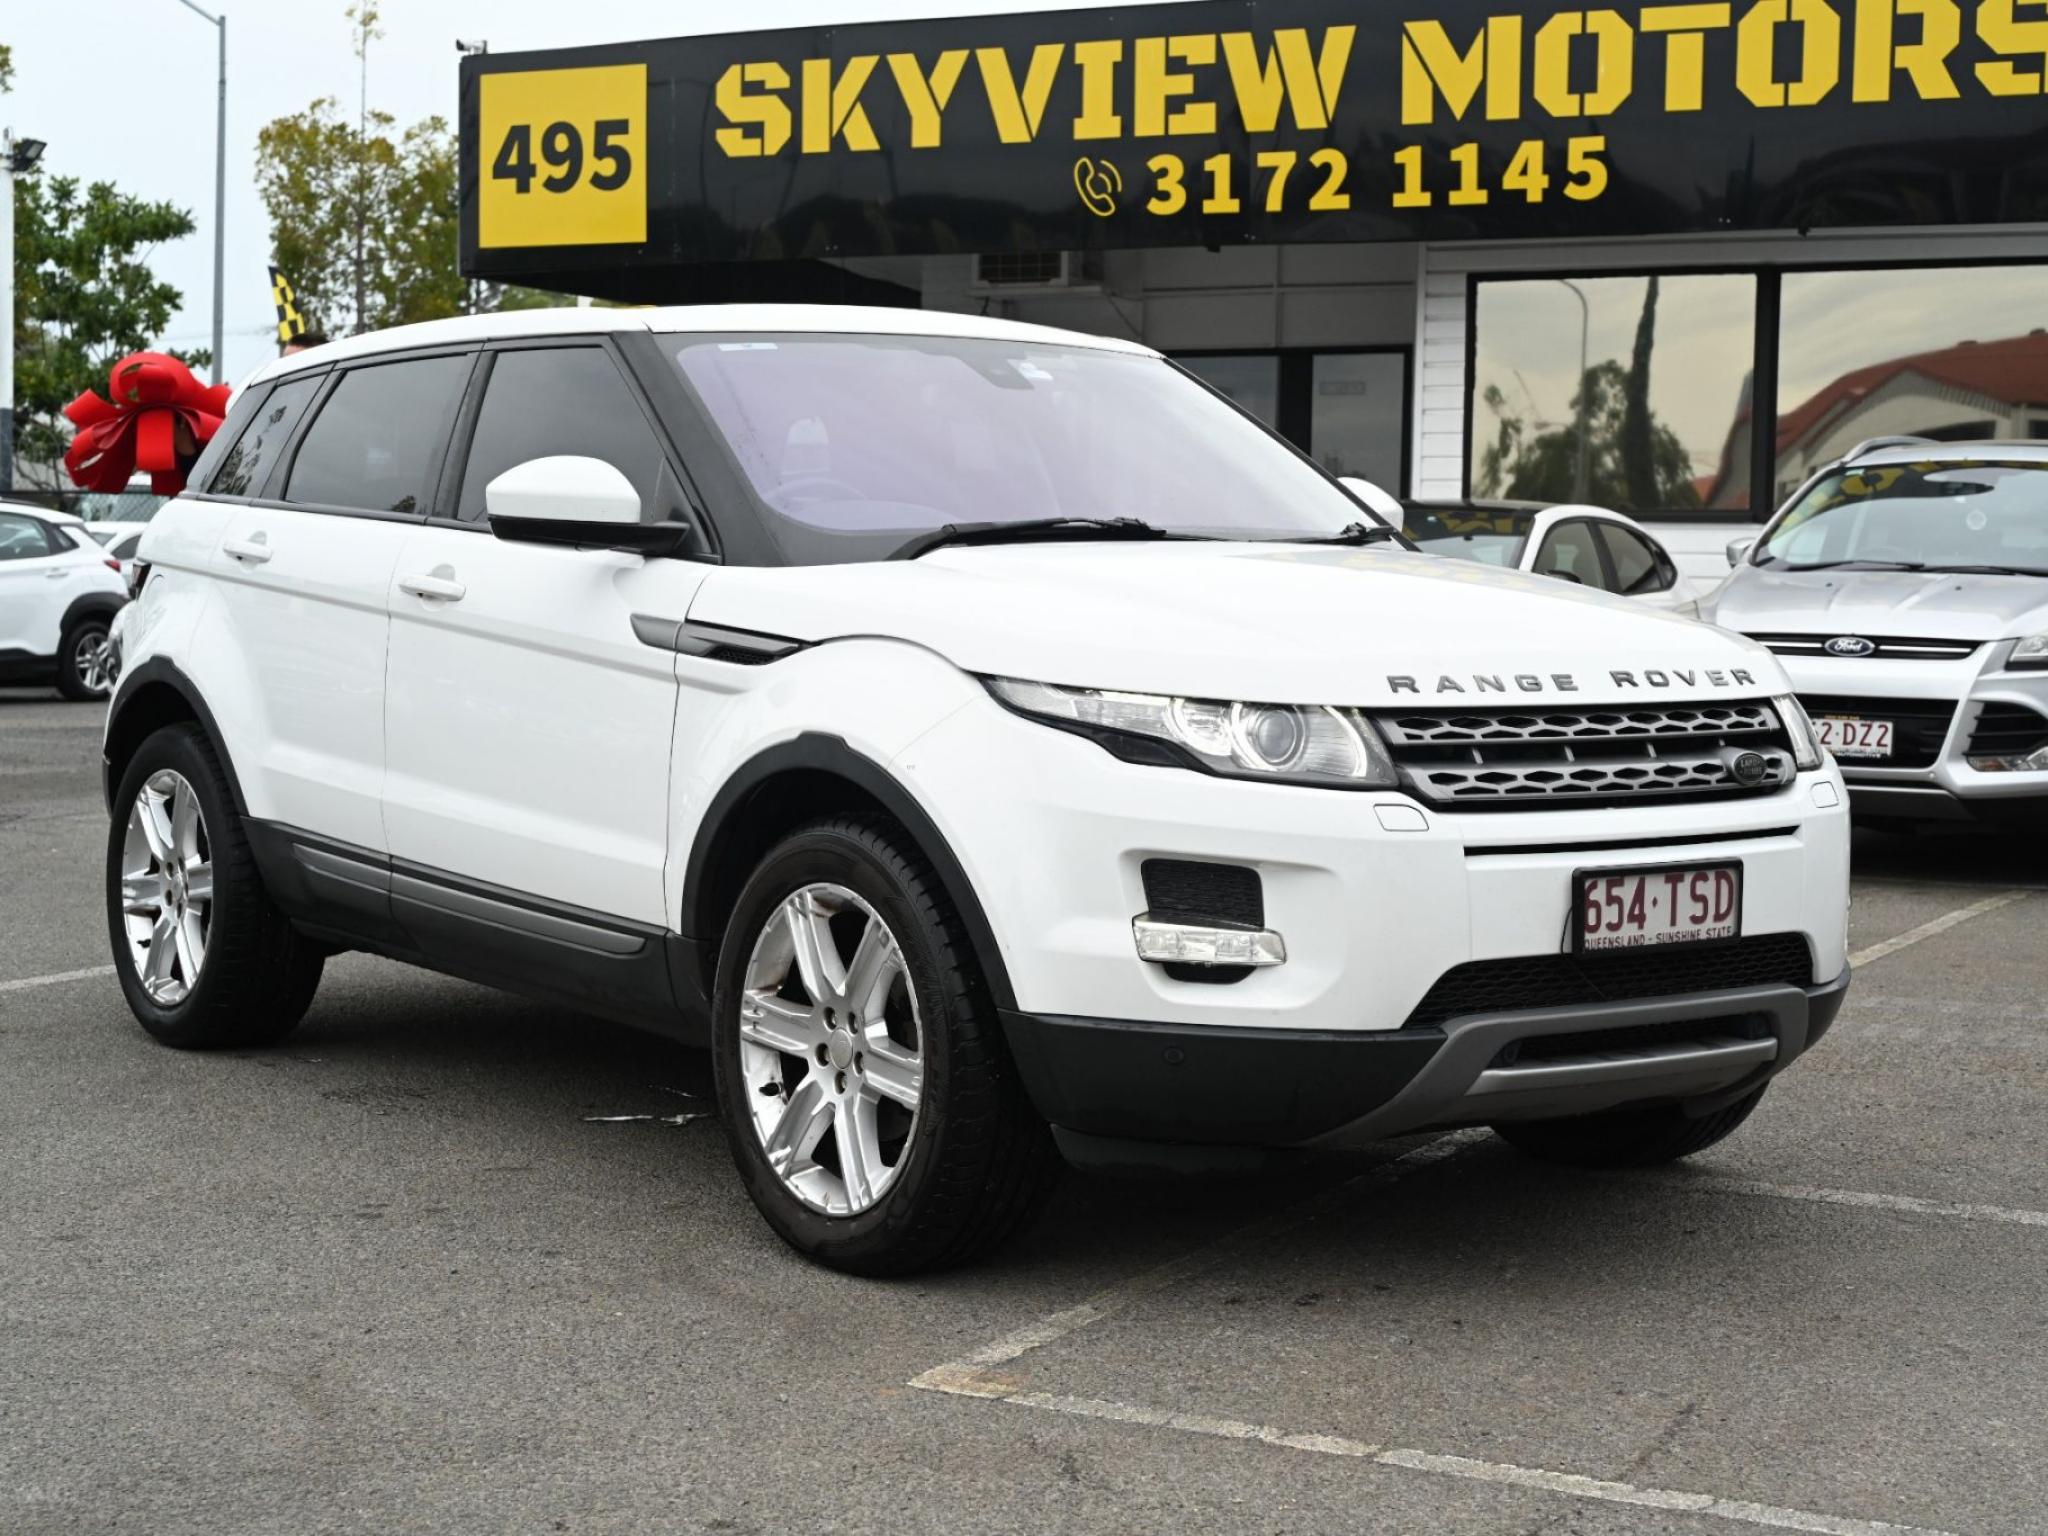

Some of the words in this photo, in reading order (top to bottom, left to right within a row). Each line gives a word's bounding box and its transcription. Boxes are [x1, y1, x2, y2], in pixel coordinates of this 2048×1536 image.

[715, 25, 1357, 157] SKYVIEW
[1401, 0, 2048, 126] MOTORS
[492, 119, 632, 193] 495
[1146, 147, 1351, 216] 3172
[1392, 135, 1609, 209] 1145
[1834, 638, 1863, 651] Ford
[1386, 674, 1580, 694] RANGE
[1609, 668, 1757, 688] ROVER
[1656, 928, 1701, 944] SUNSHINE
[1706, 925, 1732, 938] STATE
